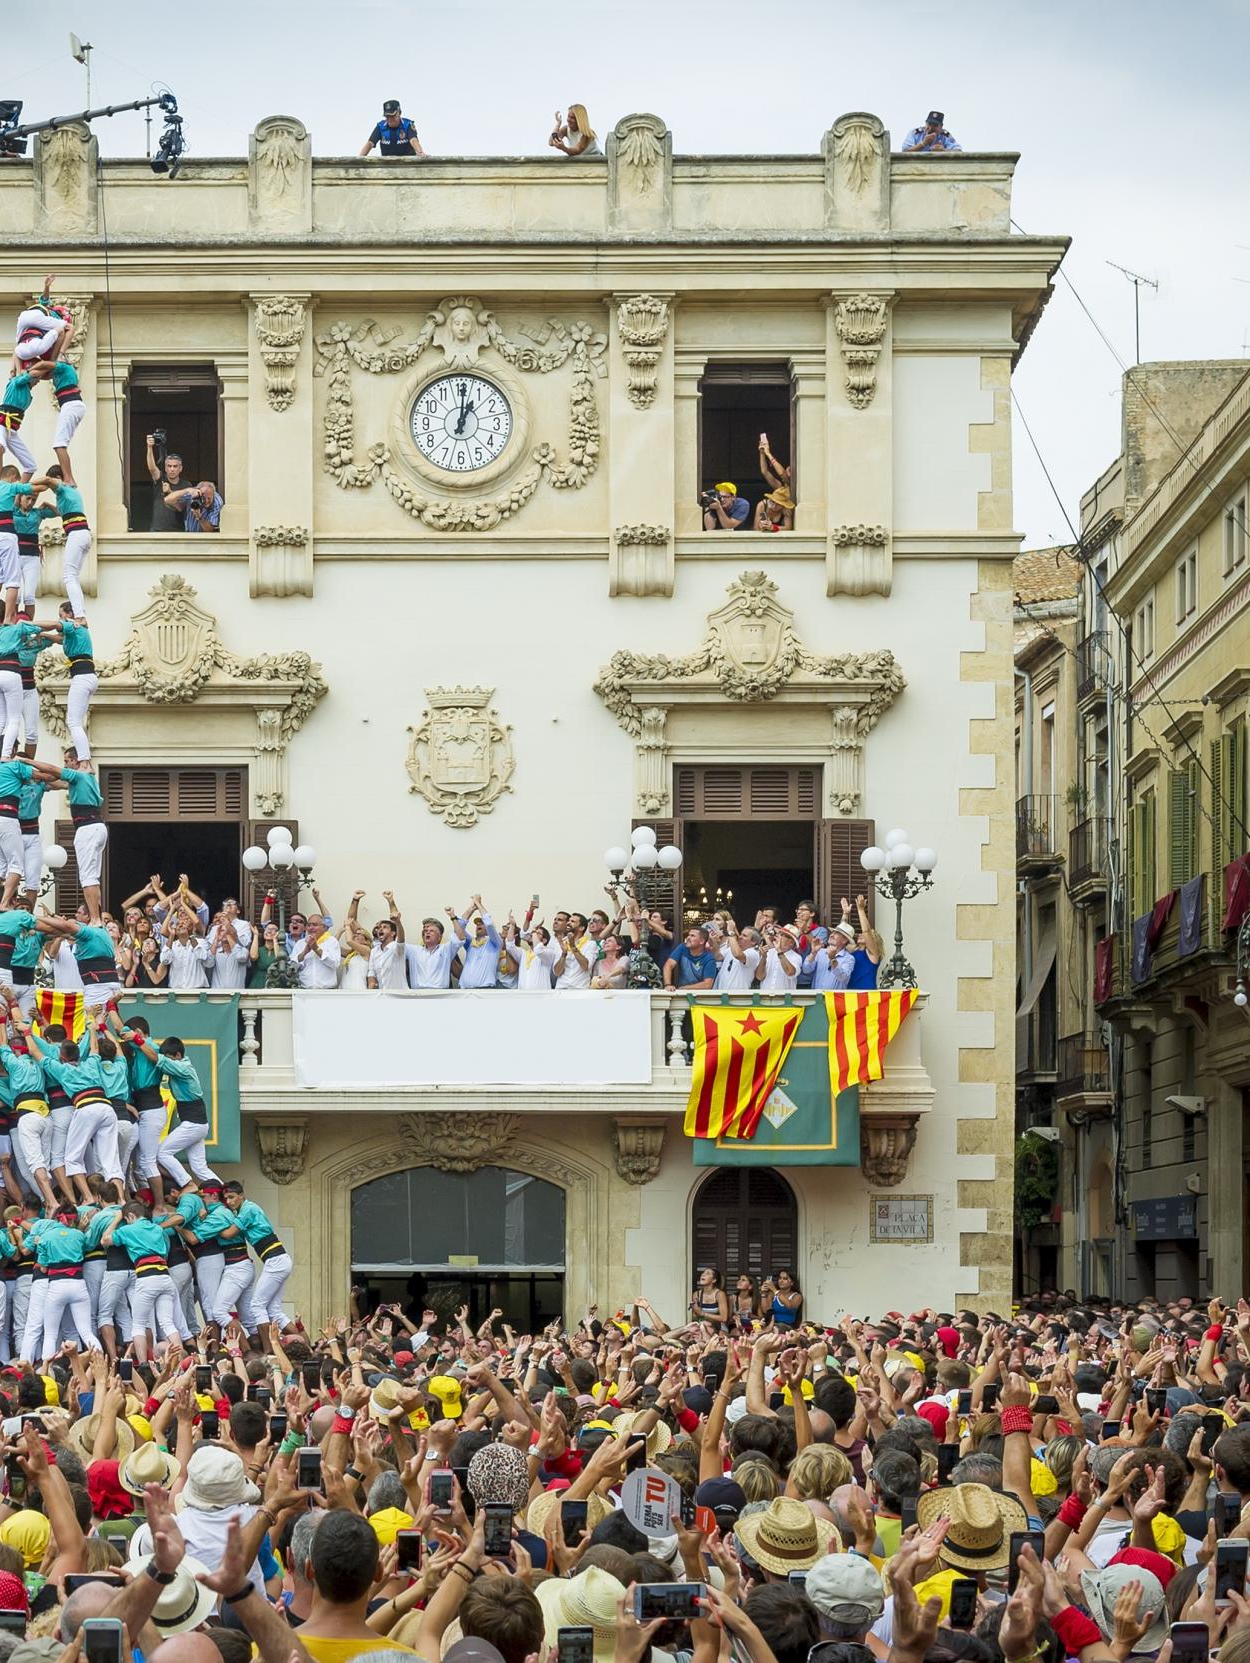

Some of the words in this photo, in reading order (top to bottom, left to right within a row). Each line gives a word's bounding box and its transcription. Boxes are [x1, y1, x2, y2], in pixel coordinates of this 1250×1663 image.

[439, 387, 447, 401] 11
[456, 383, 467, 397] 12
[476, 387, 481, 401] 1
[425, 400, 437, 413] 10
[488, 399, 496, 413] 2
[422, 417, 430, 431] 9
[493, 417, 501, 431] 3
[426, 434, 434, 448] 8
[487, 434, 494, 448] 4
[441, 447, 449, 461] 7
[457, 451, 465, 465] 6
[475, 447, 483, 461] 5
[645, 1476, 666, 1503] TU
